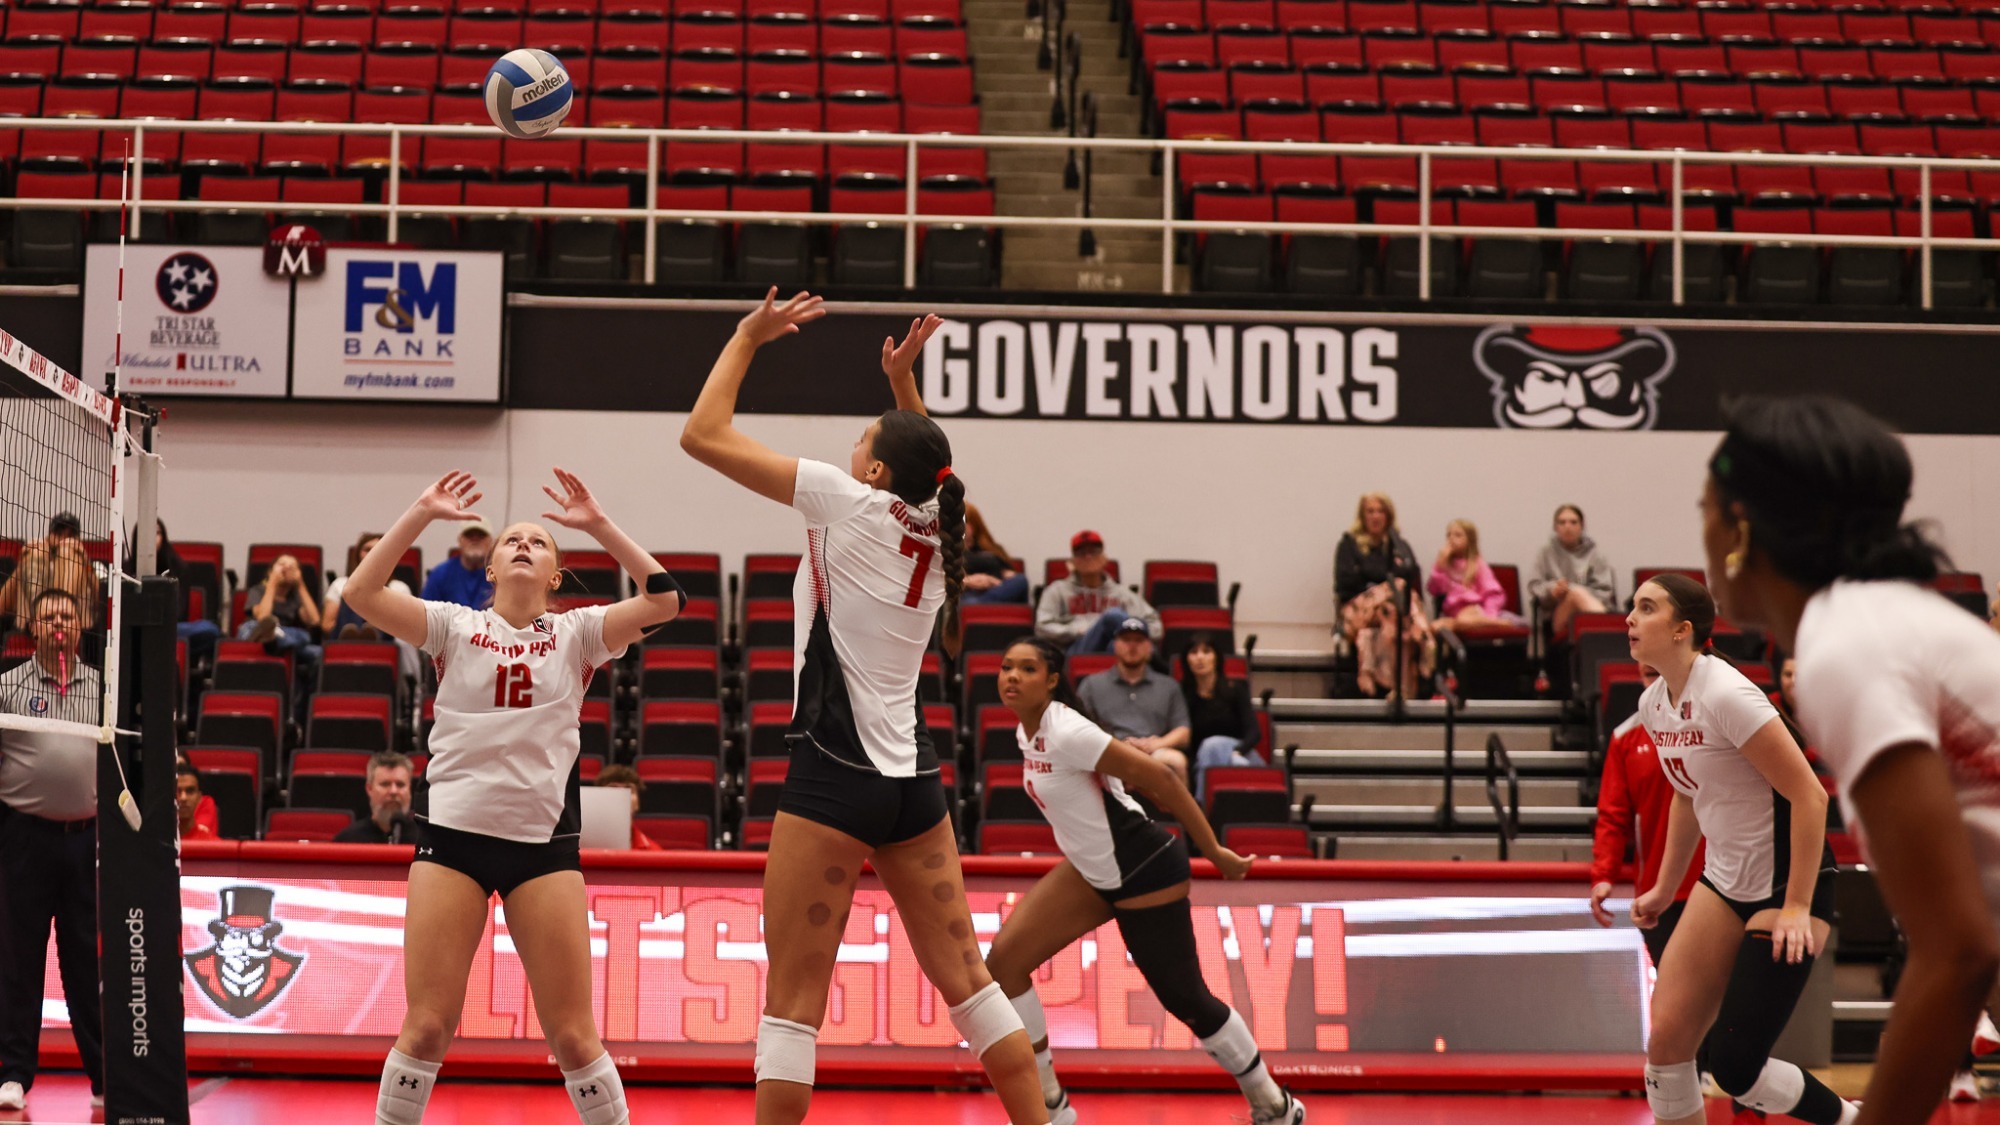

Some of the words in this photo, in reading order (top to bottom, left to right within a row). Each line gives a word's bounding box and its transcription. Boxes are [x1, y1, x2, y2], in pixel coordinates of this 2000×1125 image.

[522, 73, 565, 103] molten
[277, 246, 311, 274] M
[345, 260, 456, 334] F&M
[150, 330, 220, 345] BEVERAGE
[157, 316, 179, 330] TRI
[180, 317, 215, 330] STAR
[344, 338, 453, 357] BANK
[190, 354, 261, 372] ULTRA
[923, 319, 1398, 423] GOVERNORS
[129, 377, 162, 386] ENJOY
[166, 378, 237, 388] RESPONSIBLY
[344, 372, 455, 390] myfmbank.com
[900, 534, 935, 608] 7
[470, 632, 525, 659] AUSTIN
[494, 662, 533, 708] 12
[1663, 757, 1699, 791] 17
[125, 907, 148, 973] sports
[461, 887, 760, 1043] LT'S
[128, 976, 150, 1057] imports
[1273, 1064, 1363, 1076] DAKTRONICS
